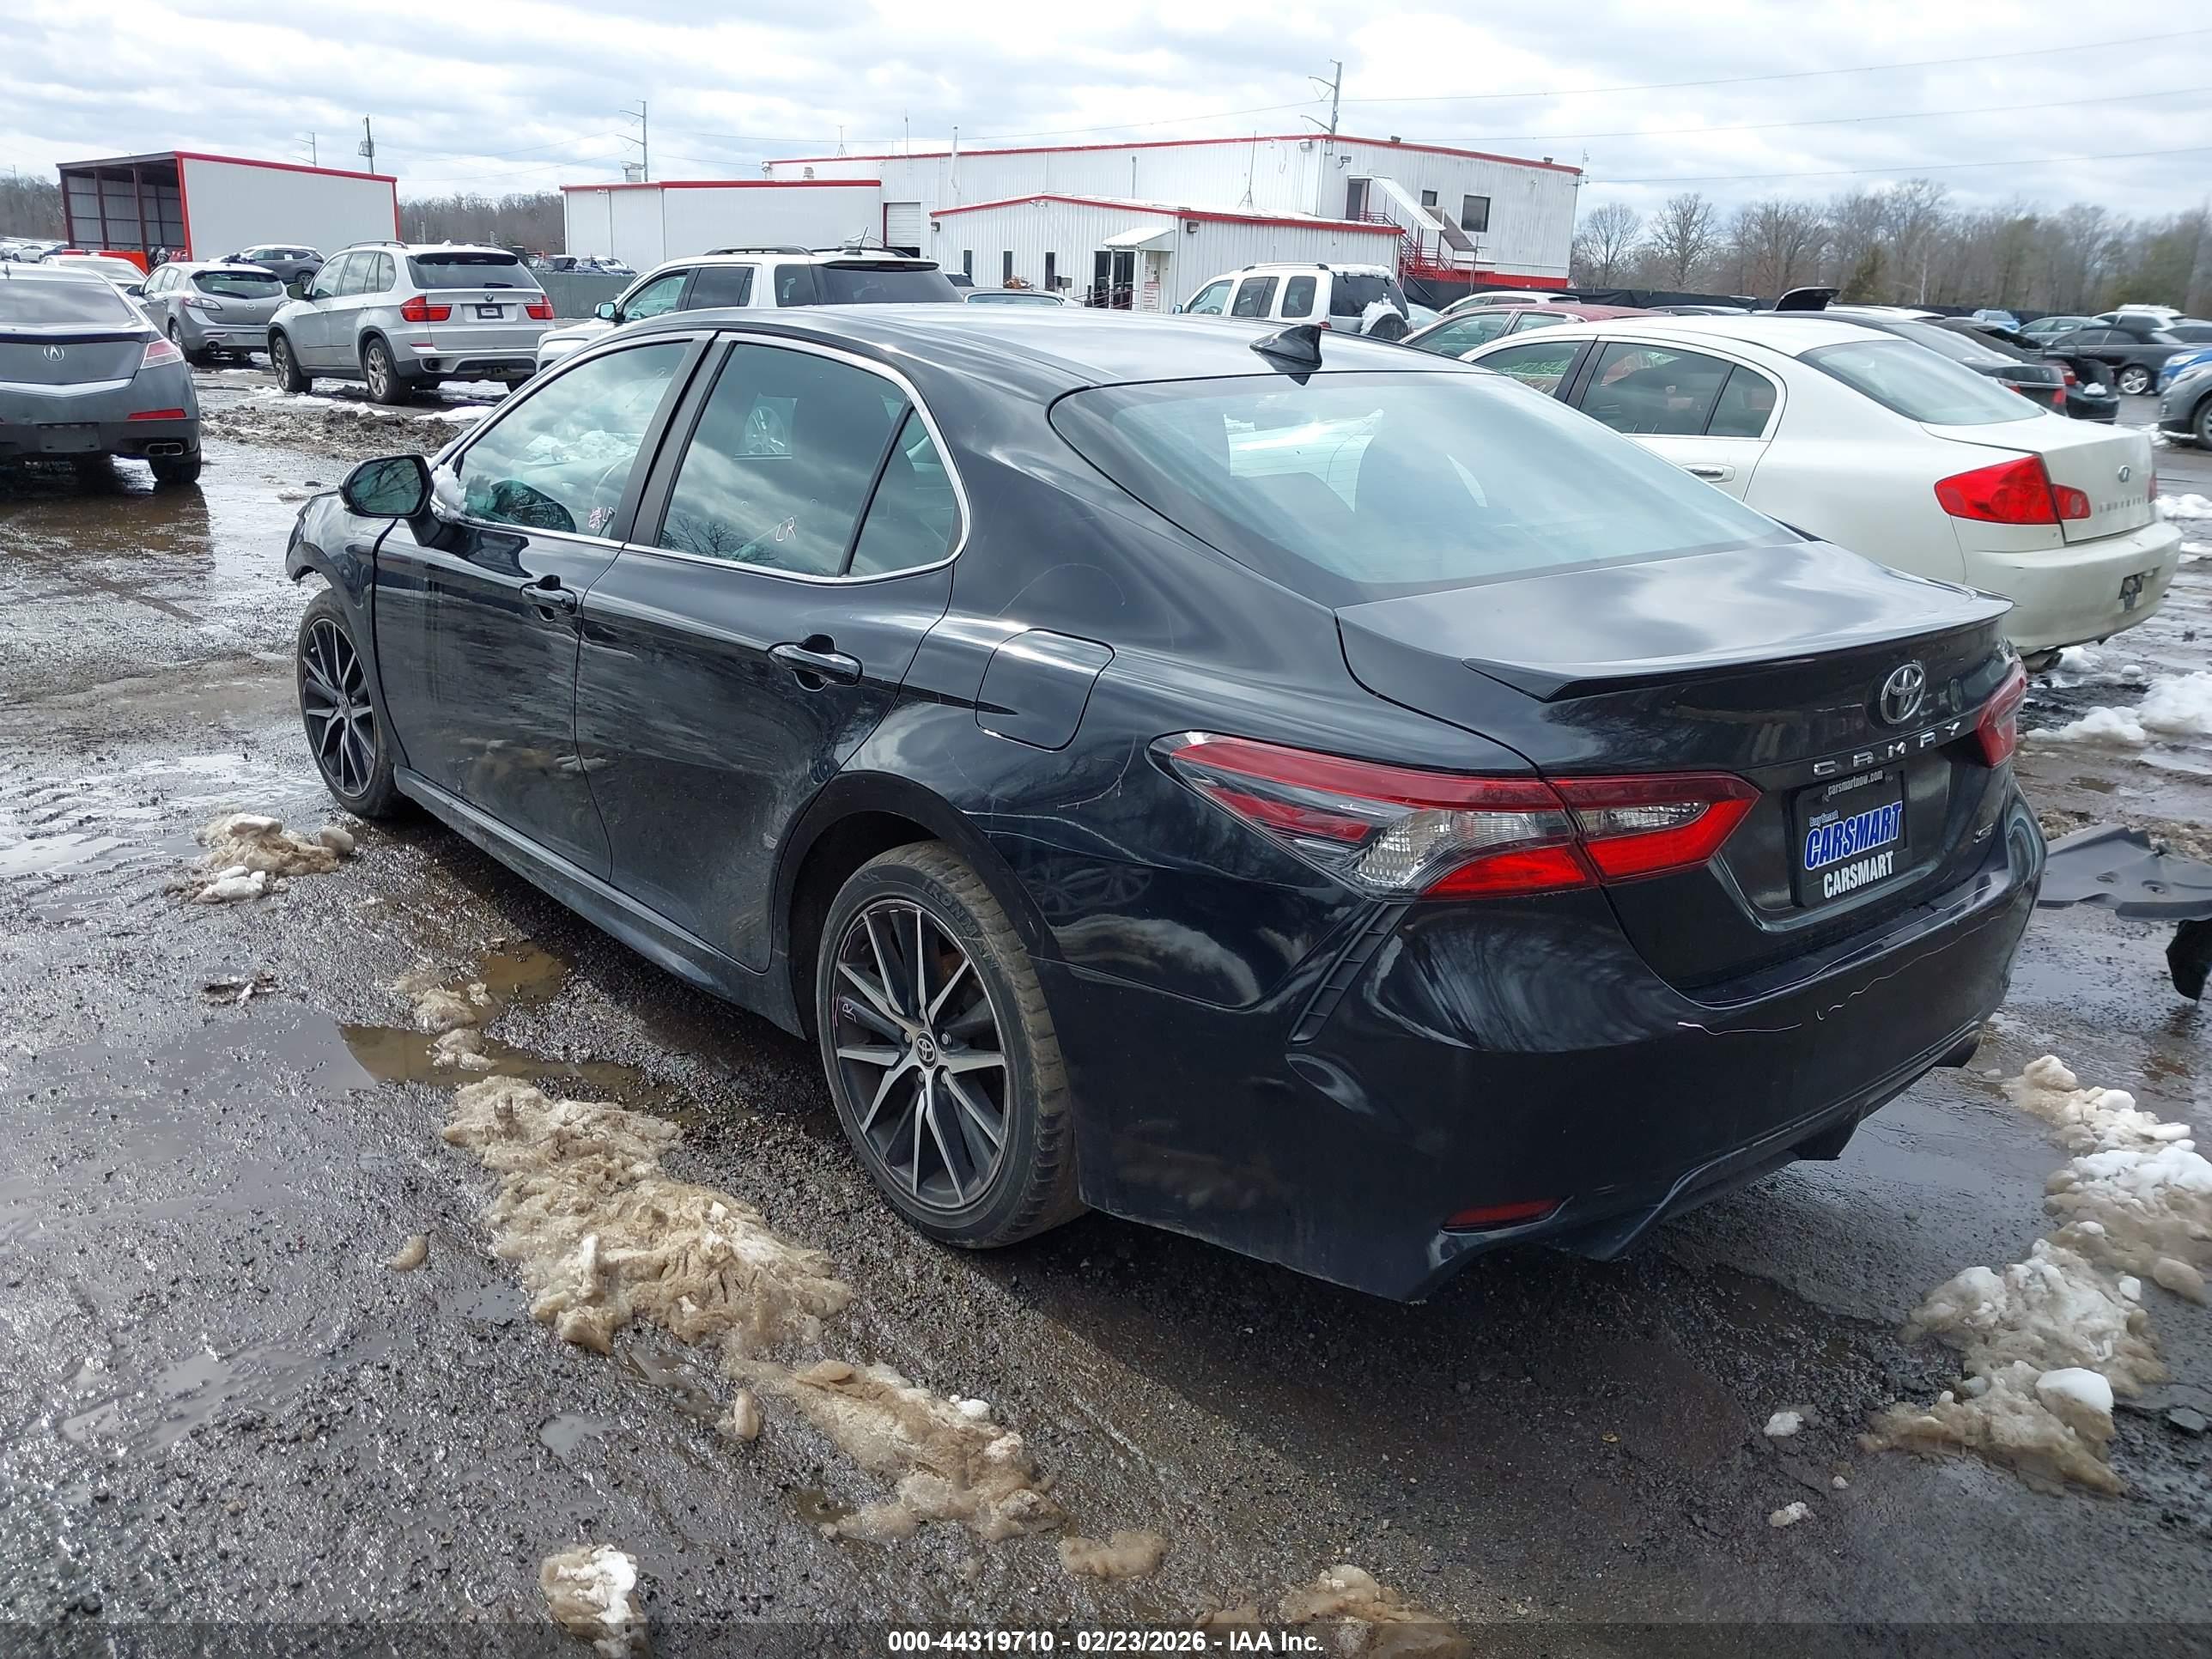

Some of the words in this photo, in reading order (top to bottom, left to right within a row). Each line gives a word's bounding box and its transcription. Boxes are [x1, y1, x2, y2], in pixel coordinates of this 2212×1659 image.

[775, 516, 796, 542] LR
[1814, 721, 1960, 776] CAMRY
[1827, 769, 1883, 796] carsmartnow.com
[1804, 799, 1903, 871] CARSMART
[1823, 850, 1894, 899] CARSMART
[921, 878, 1000, 969] IRONMAN
